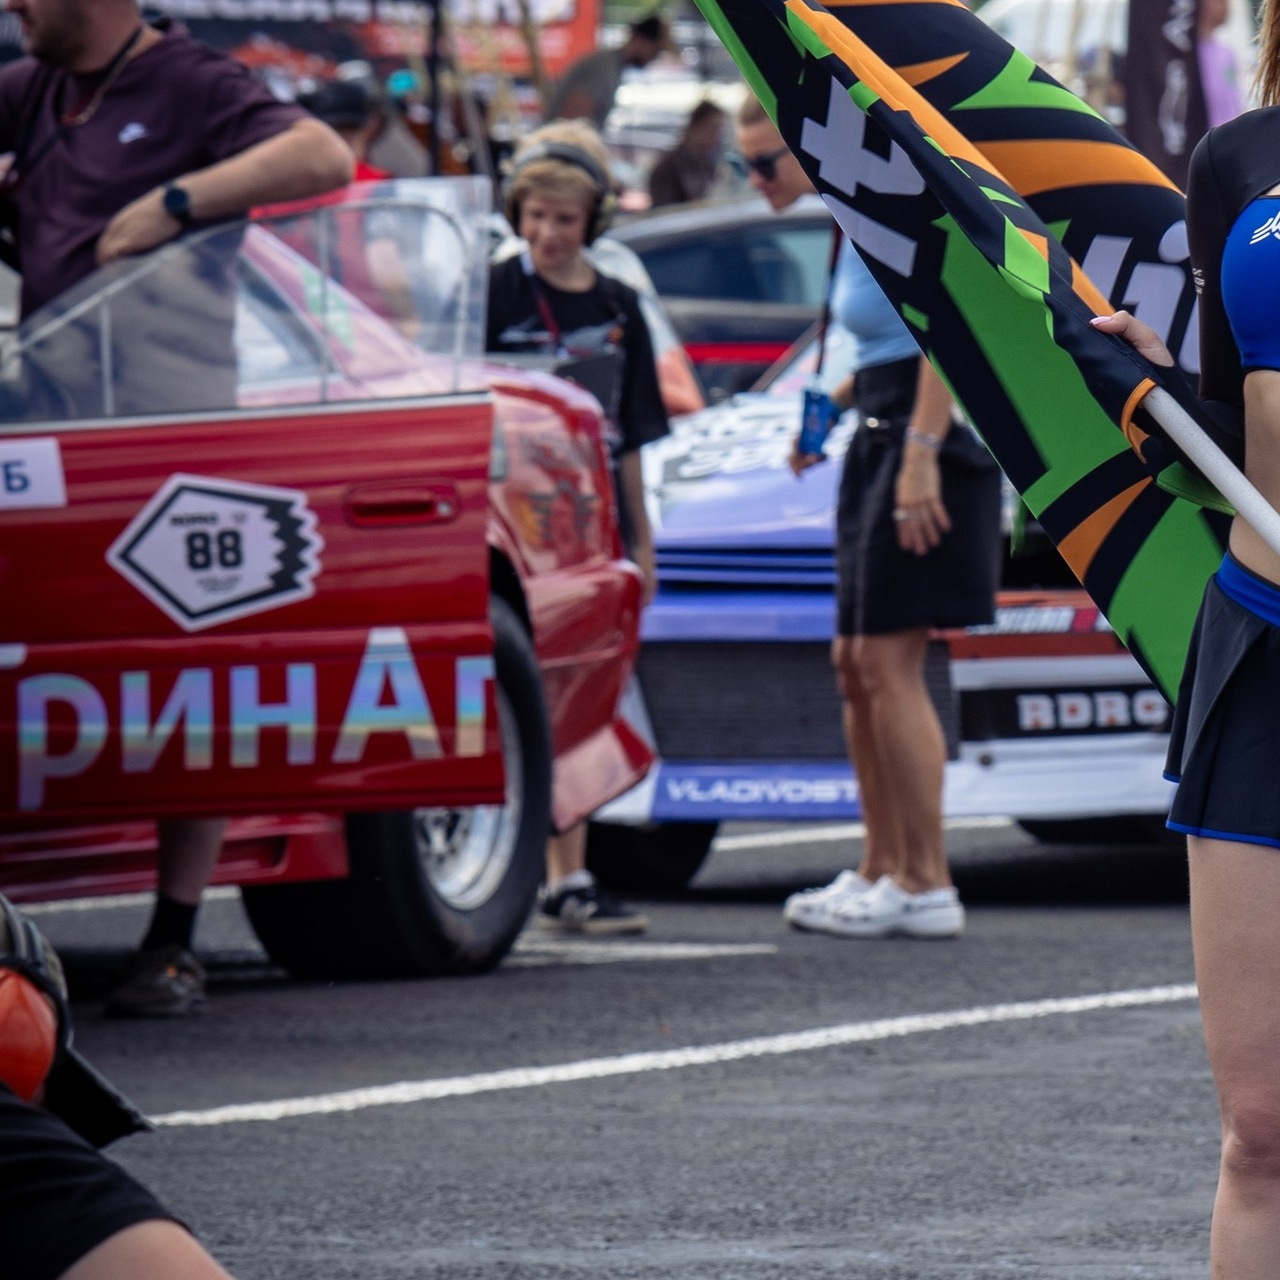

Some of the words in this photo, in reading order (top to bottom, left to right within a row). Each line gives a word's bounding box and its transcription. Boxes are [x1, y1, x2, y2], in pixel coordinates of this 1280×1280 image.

[185, 529, 243, 570] 88
[1016, 687, 1170, 731] RDRC
[666, 777, 860, 803] VLADIVOST
